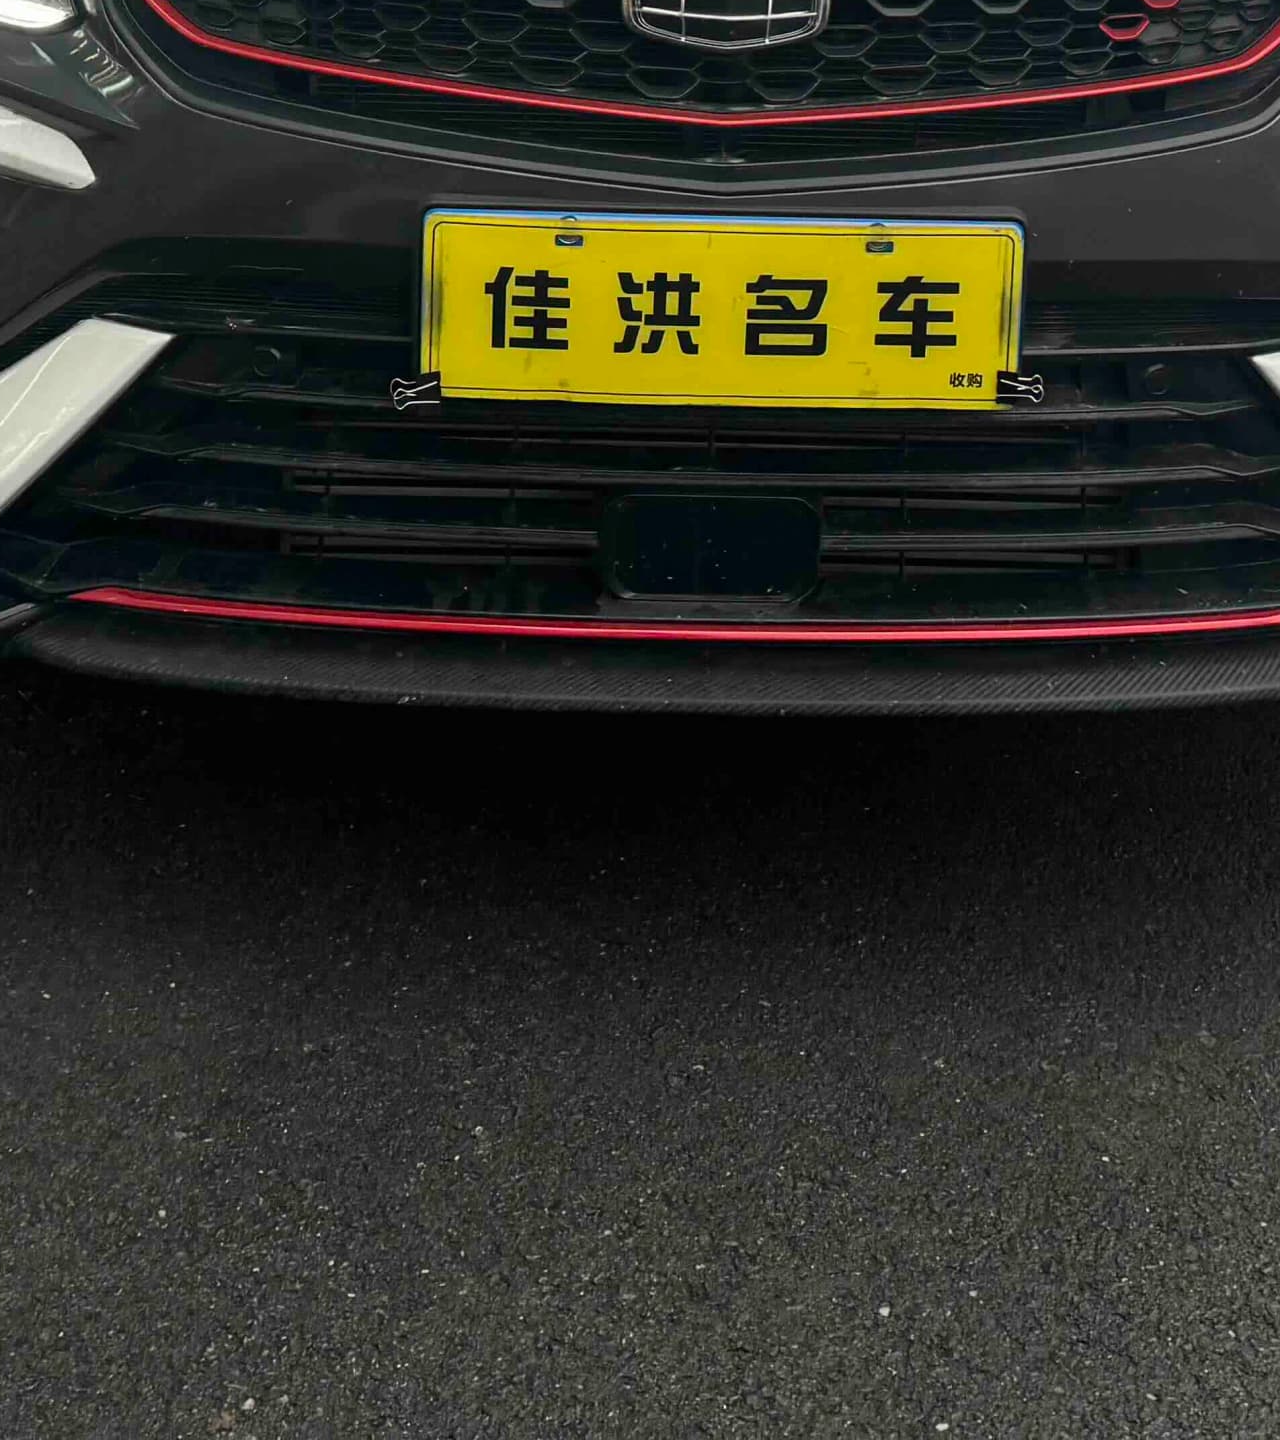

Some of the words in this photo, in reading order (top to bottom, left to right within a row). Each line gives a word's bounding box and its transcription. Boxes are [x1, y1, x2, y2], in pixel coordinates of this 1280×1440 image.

[484, 266, 961, 359] 佳洪名车
[948, 371, 984, 390] 收购
